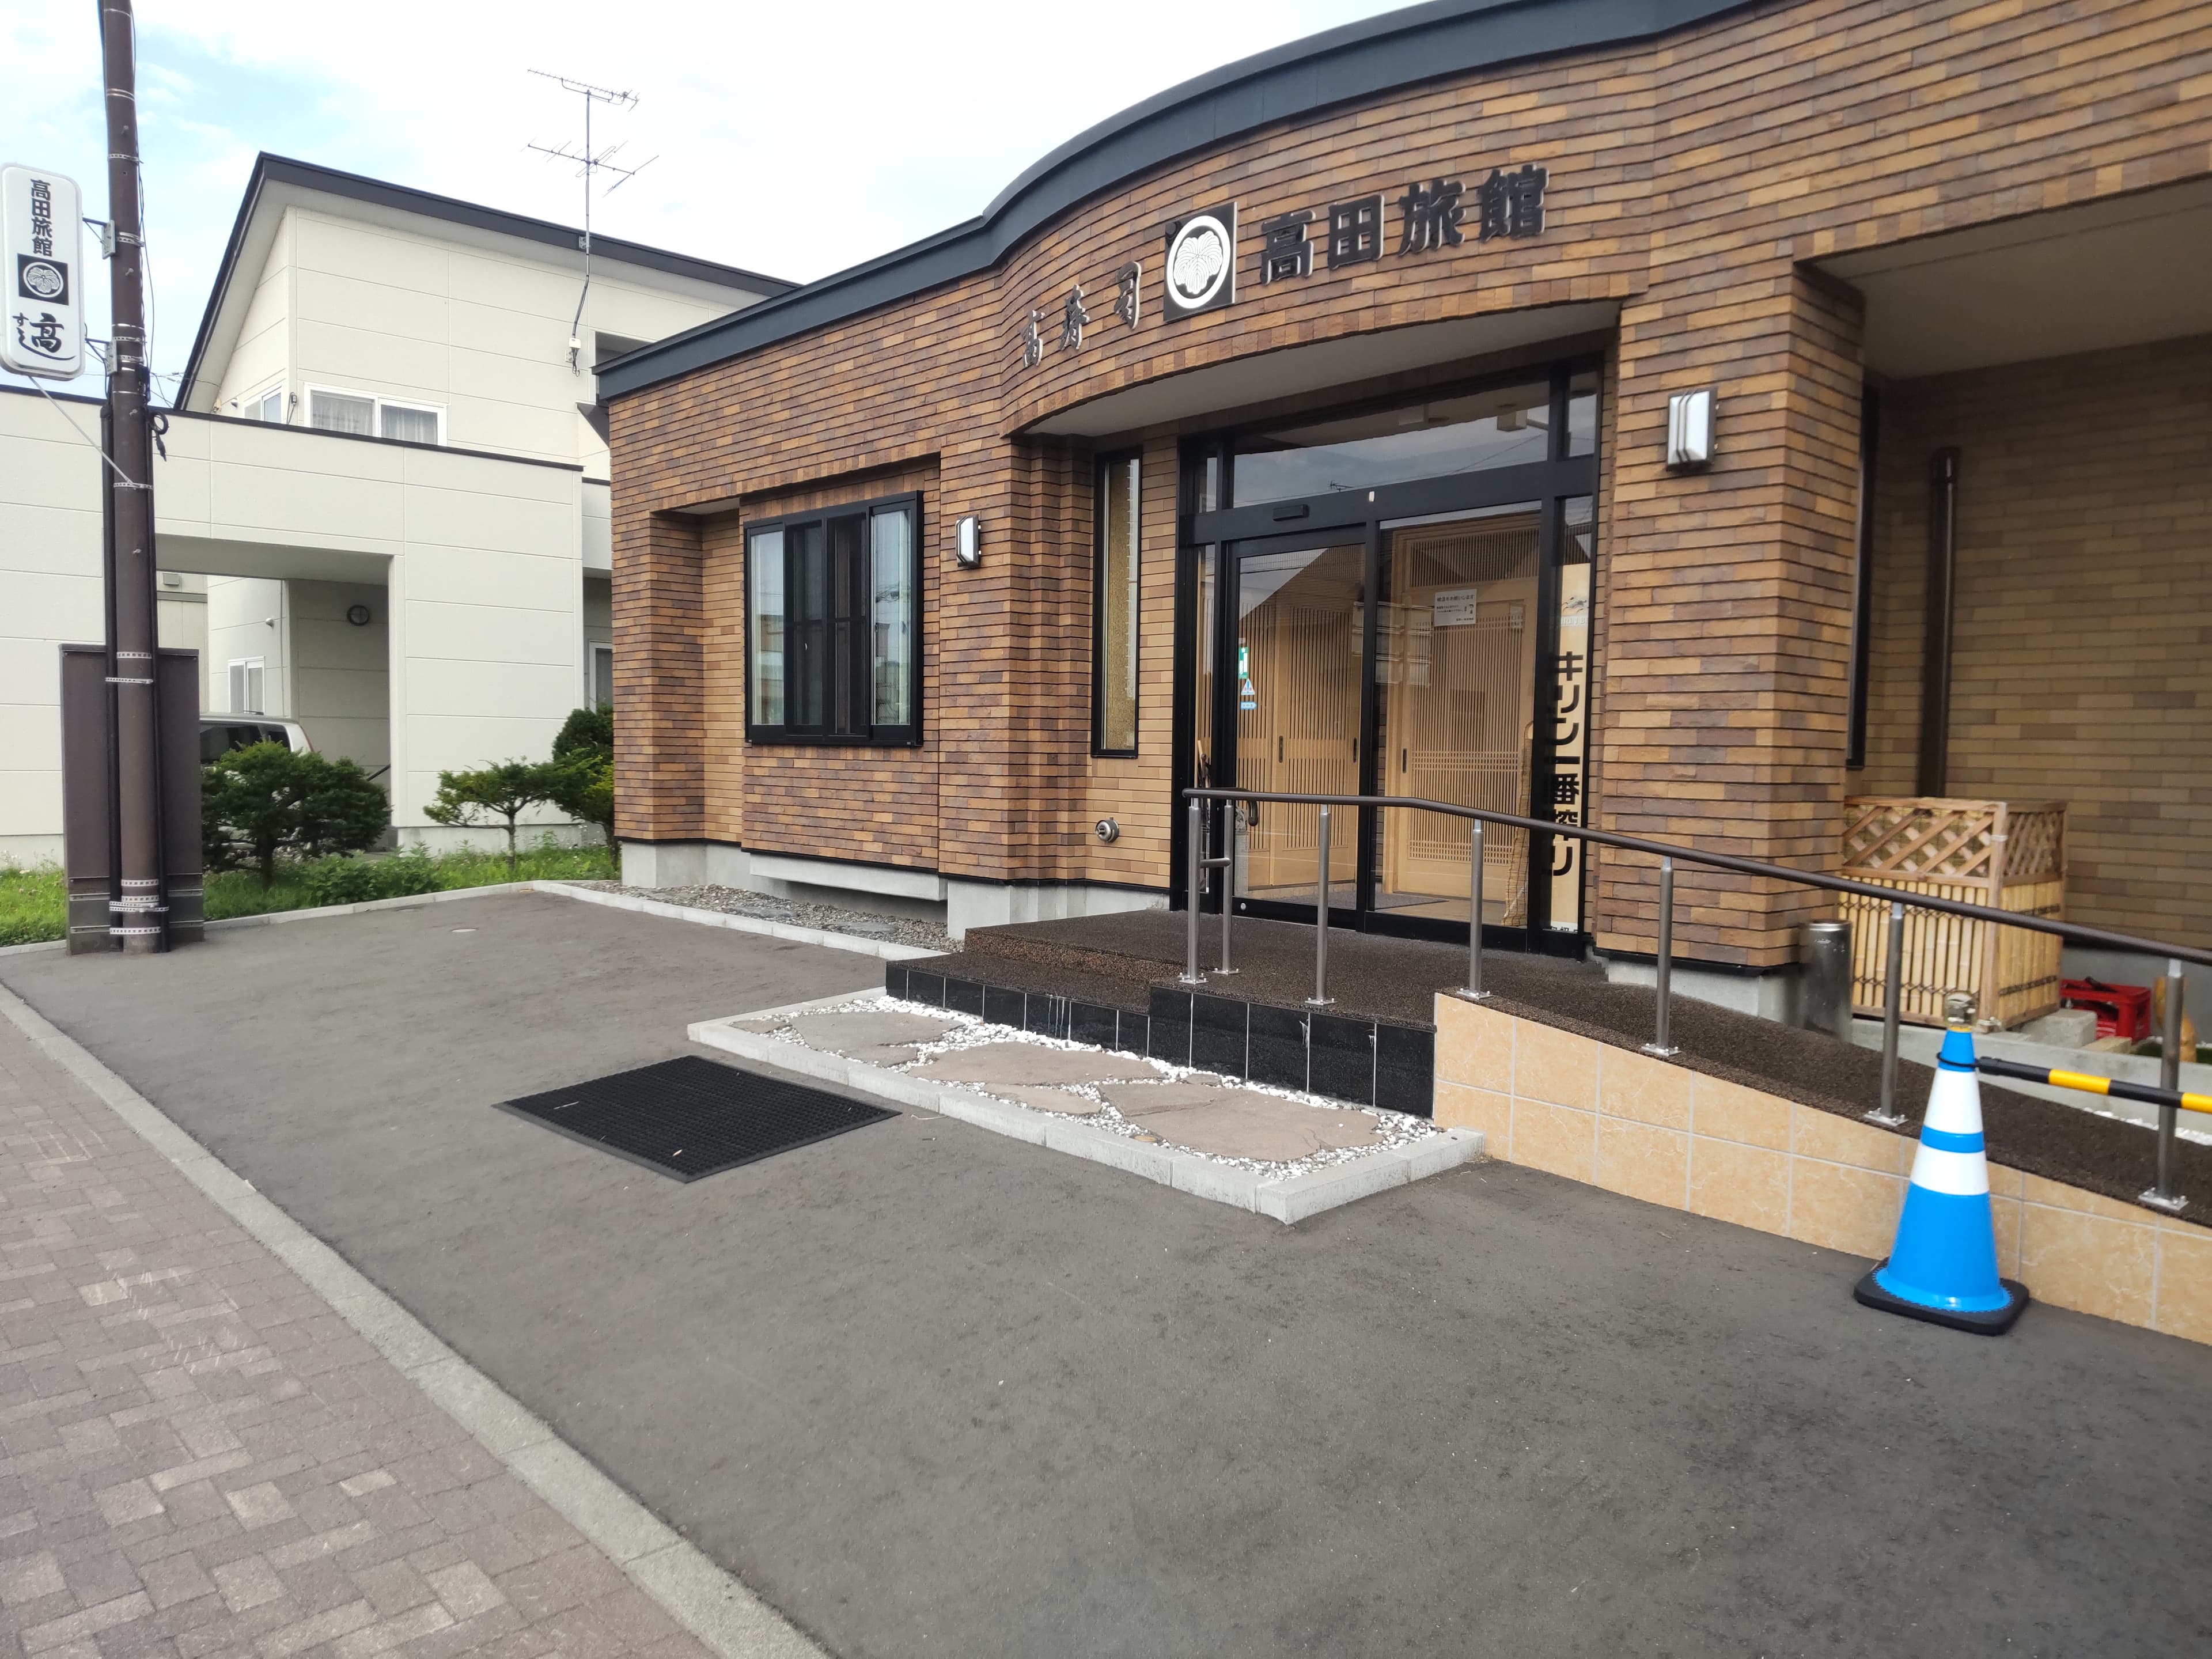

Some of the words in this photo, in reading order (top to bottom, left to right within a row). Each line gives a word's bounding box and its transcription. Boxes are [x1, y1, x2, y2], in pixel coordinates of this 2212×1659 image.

[31, 179, 52, 257] 高田旅館
[1260, 163, 1549, 286] 高田旅館
